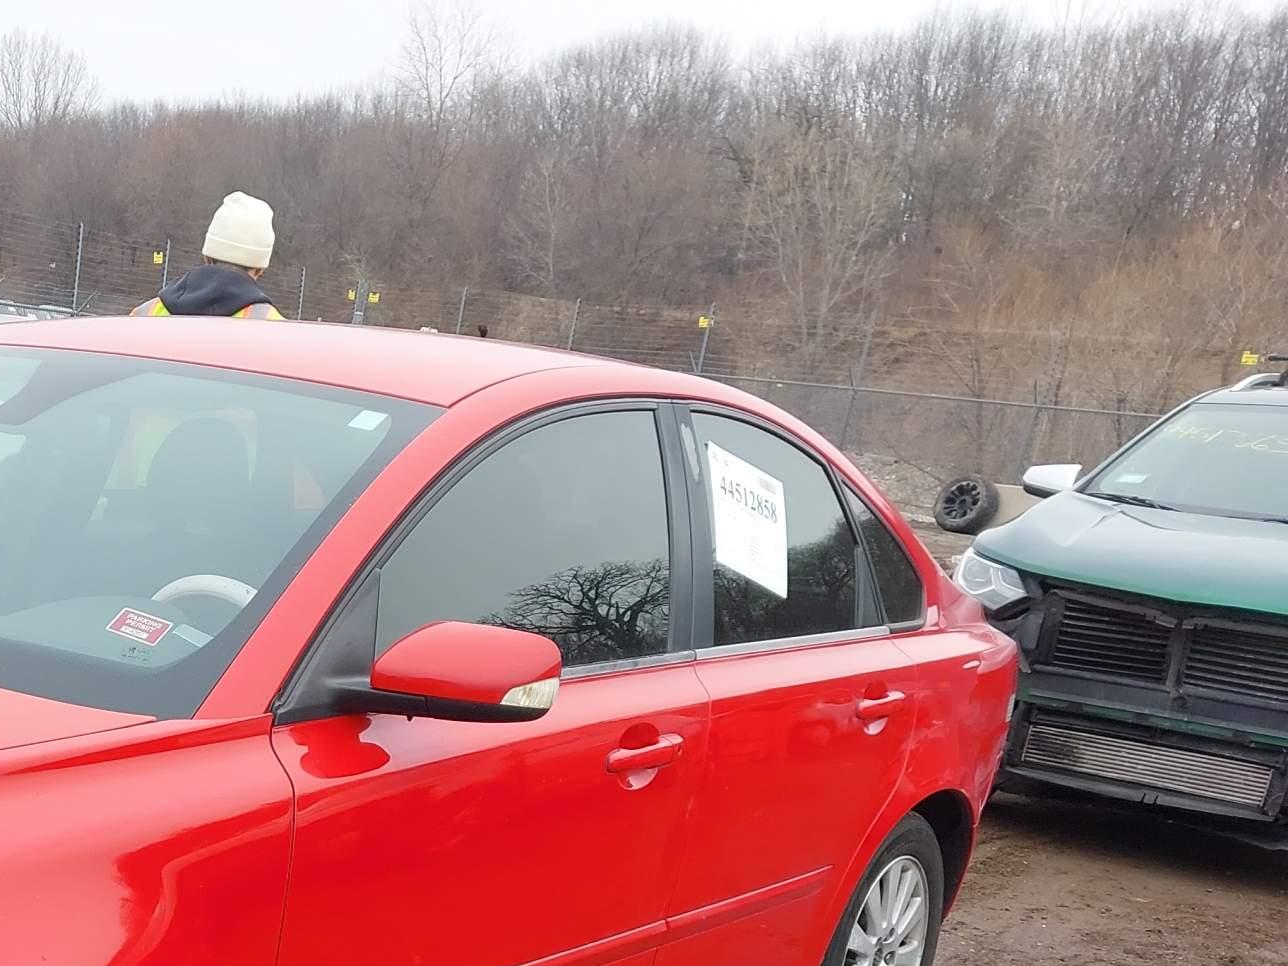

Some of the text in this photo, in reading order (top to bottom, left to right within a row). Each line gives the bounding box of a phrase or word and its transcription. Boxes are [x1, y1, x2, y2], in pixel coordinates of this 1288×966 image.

[720, 475, 778, 523] 44512858
[125, 618, 157, 632] PERMIT
[127, 613, 163, 629] PARKING
